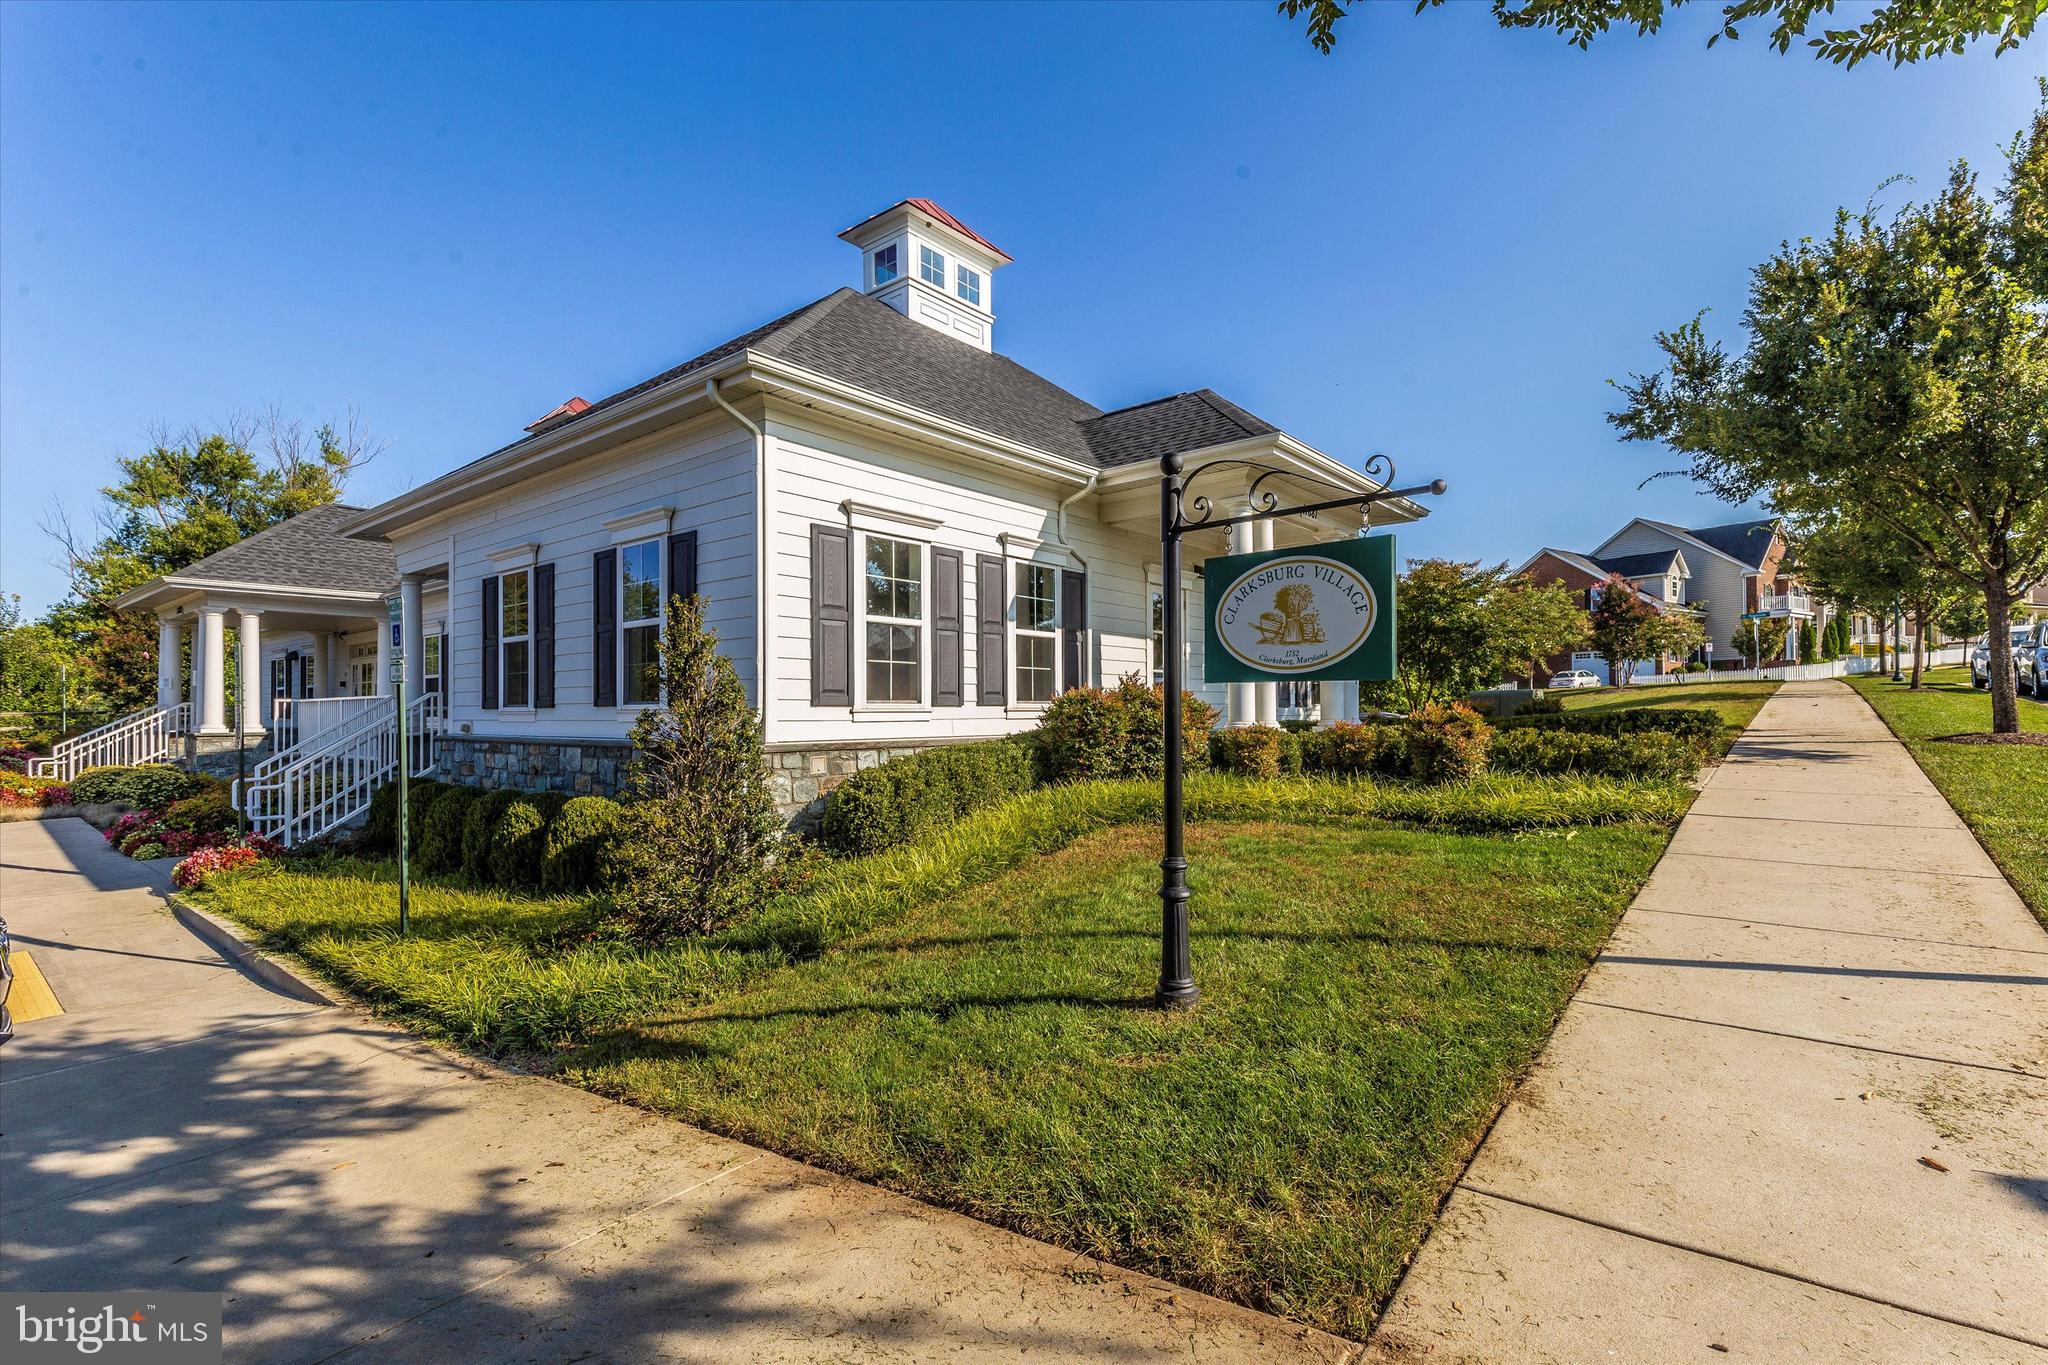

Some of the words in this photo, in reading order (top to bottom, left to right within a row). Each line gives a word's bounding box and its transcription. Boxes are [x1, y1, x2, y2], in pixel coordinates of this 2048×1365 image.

[1224, 565, 1304, 625] CLARKSBURG
[1314, 565, 1369, 615] VILLAGE
[1259, 654, 1295, 665] Clarksburg,
[1296, 650, 1328, 664] Maryland
[1285, 650, 1300, 658] 1752
